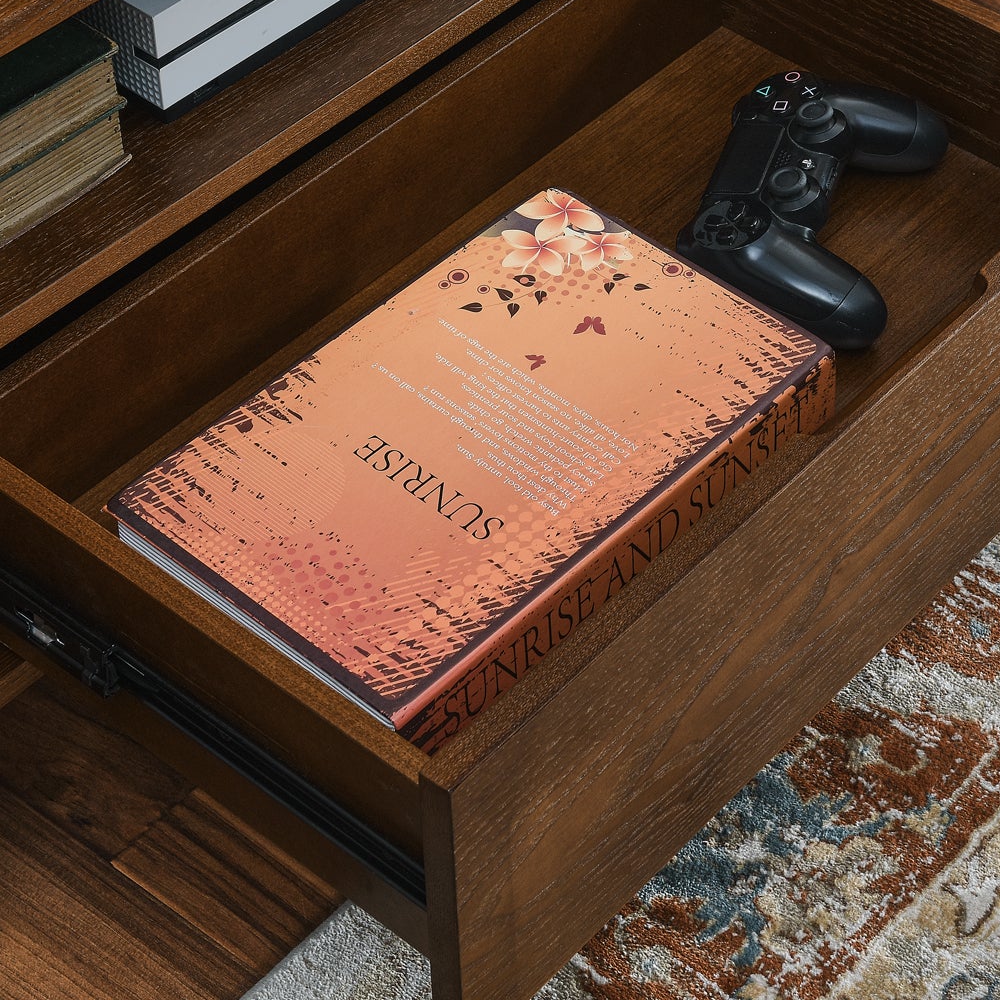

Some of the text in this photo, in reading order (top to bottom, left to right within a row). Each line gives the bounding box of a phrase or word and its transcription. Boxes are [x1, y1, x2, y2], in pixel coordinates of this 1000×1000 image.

[466, 336, 486, 350] rags
[482, 349, 498, 360] the
[488, 365, 504, 376] nor
[497, 358, 512, 368] are
[387, 372, 400, 382] on
[450, 366, 468, 378] will
[510, 367, 536, 385] which
[398, 381, 416, 393] call
[466, 374, 488, 391] king
[503, 375, 532, 395] knows
[485, 388, 500, 400] the
[444, 399, 476, 420] seasons
[466, 401, 490, 418] chide
[499, 398, 518, 410] that
[510, 392, 542, 414] harvest
[531, 392, 560, 412] season
[490, 416, 504, 426] go
[498, 409, 518, 422] sour
[559, 411, 572, 420] no
[449, 414, 484, 438] through
[516, 421, 534, 434] and
[516, 408, 584, 453] court-huntsmen
[550, 418, 570, 432] ants
[481, 436, 500, 450] and
[568, 428, 604, 453] country
[593, 434, 606, 442] all
[618, 436, 639, 452] Nor
[502, 437, 538, 462] motions
[533, 431, 586, 467] school-boys
[532, 444, 572, 470] pedantic
[582, 452, 598, 462] tell
[601, 451, 622, 465] Call
[472, 456, 504, 478] unruly
[505, 465, 527, 481] thou
[536, 460, 554, 472] thy
[584, 465, 604, 480] Late
[597, 461, 613, 472] Go
[568, 468, 596, 486] Saucy
[353, 435, 504, 540] SUNRISE
[526, 479, 546, 494] dost
[539, 474, 579, 502] Through
[562, 476, 587, 494] Must
[520, 490, 538, 502] old
[544, 490, 570, 509] Why
[537, 499, 562, 516] Busy
[442, 394, 809, 735] SUNRISE AND SUNSET
